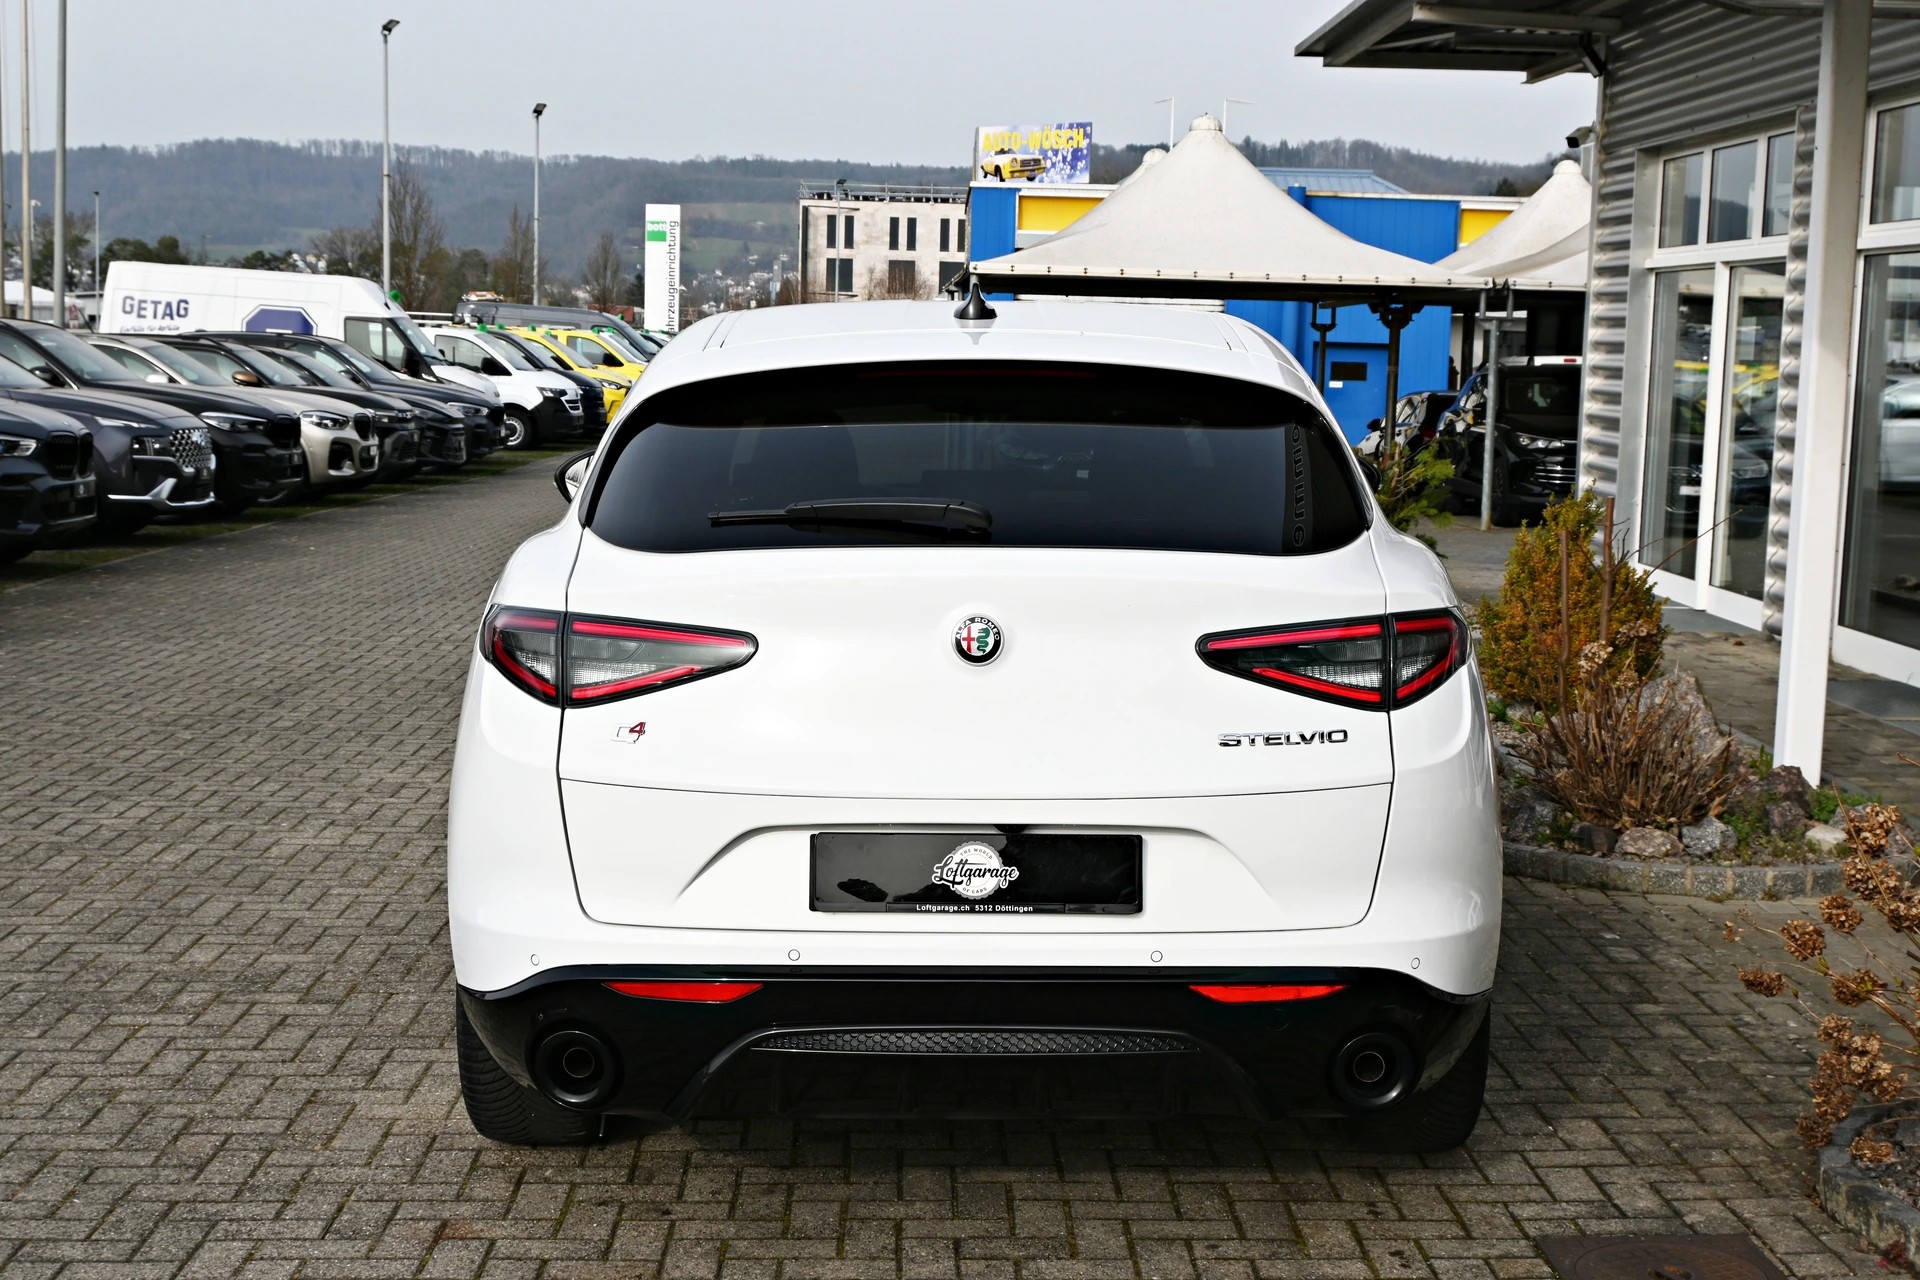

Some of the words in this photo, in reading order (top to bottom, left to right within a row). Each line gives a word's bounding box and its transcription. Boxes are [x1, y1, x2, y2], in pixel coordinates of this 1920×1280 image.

[982, 126, 1085, 151] AUTO-WÖSCH
[666, 221, 679, 332] ahrzeugeinrichtung
[122, 296, 189, 320] GETAG
[956, 620, 971, 639] ALFA
[975, 617, 1000, 640] ROMEO
[1217, 729, 1349, 747] STELVIO
[960, 848, 972, 857] THE
[973, 847, 993, 860] WORLD
[935, 856, 1018, 889] Loftgarage
[916, 904, 970, 913] Loftgarage.ch
[975, 904, 993, 912] 5312
[995, 904, 1034, 914] Döttingen
